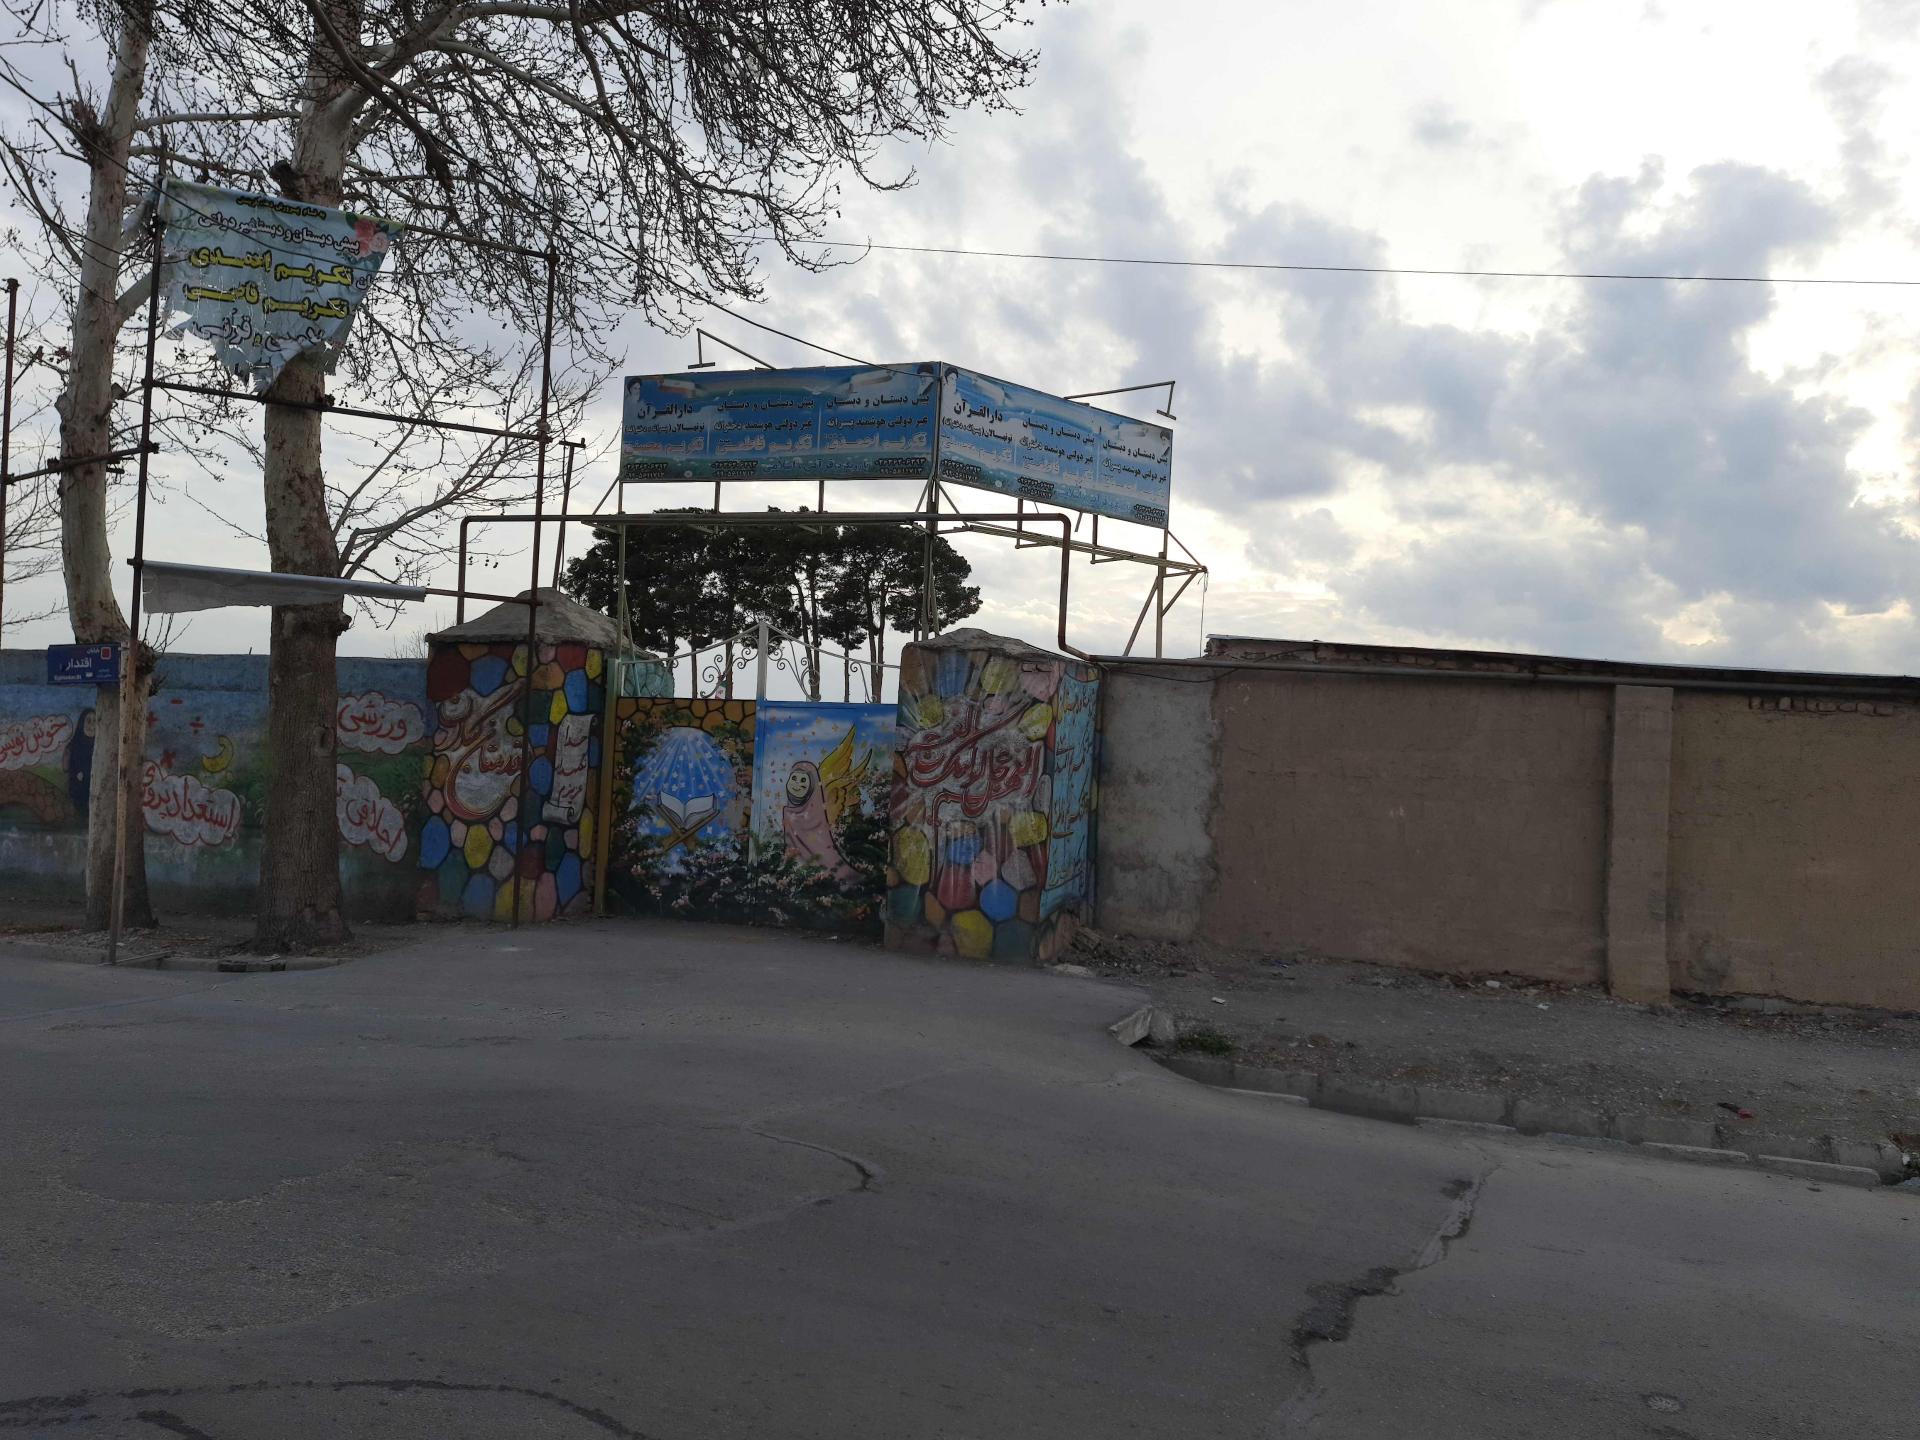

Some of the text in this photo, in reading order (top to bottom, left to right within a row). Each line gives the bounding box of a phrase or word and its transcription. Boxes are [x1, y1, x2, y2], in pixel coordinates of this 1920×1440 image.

[198, 211, 238, 231] دولتی
[284, 228, 294, 243] و
[293, 225, 334, 249] دبستان
[334, 235, 361, 256] پیش
[273, 261, 354, 288] تکریم
[262, 296, 351, 321] تکریم
[761, 398, 794, 411] دبستان
[864, 399, 870, 408] و
[872, 393, 909, 407] دبستان
[855, 416, 888, 429] هوشمند
[887, 415, 913, 428] دولتی
[1022, 416, 1049, 432] دبستان
[1055, 426, 1081, 441] دبستان
[1102, 439, 1126, 454] دبستان
[1132, 447, 1156, 460] دبستان
[64, 656, 93, 672] اقتدار
[337, 700, 408, 741] ورزشی
[25, 719, 68, 754] خوش
[166, 777, 236, 833] استعداد
